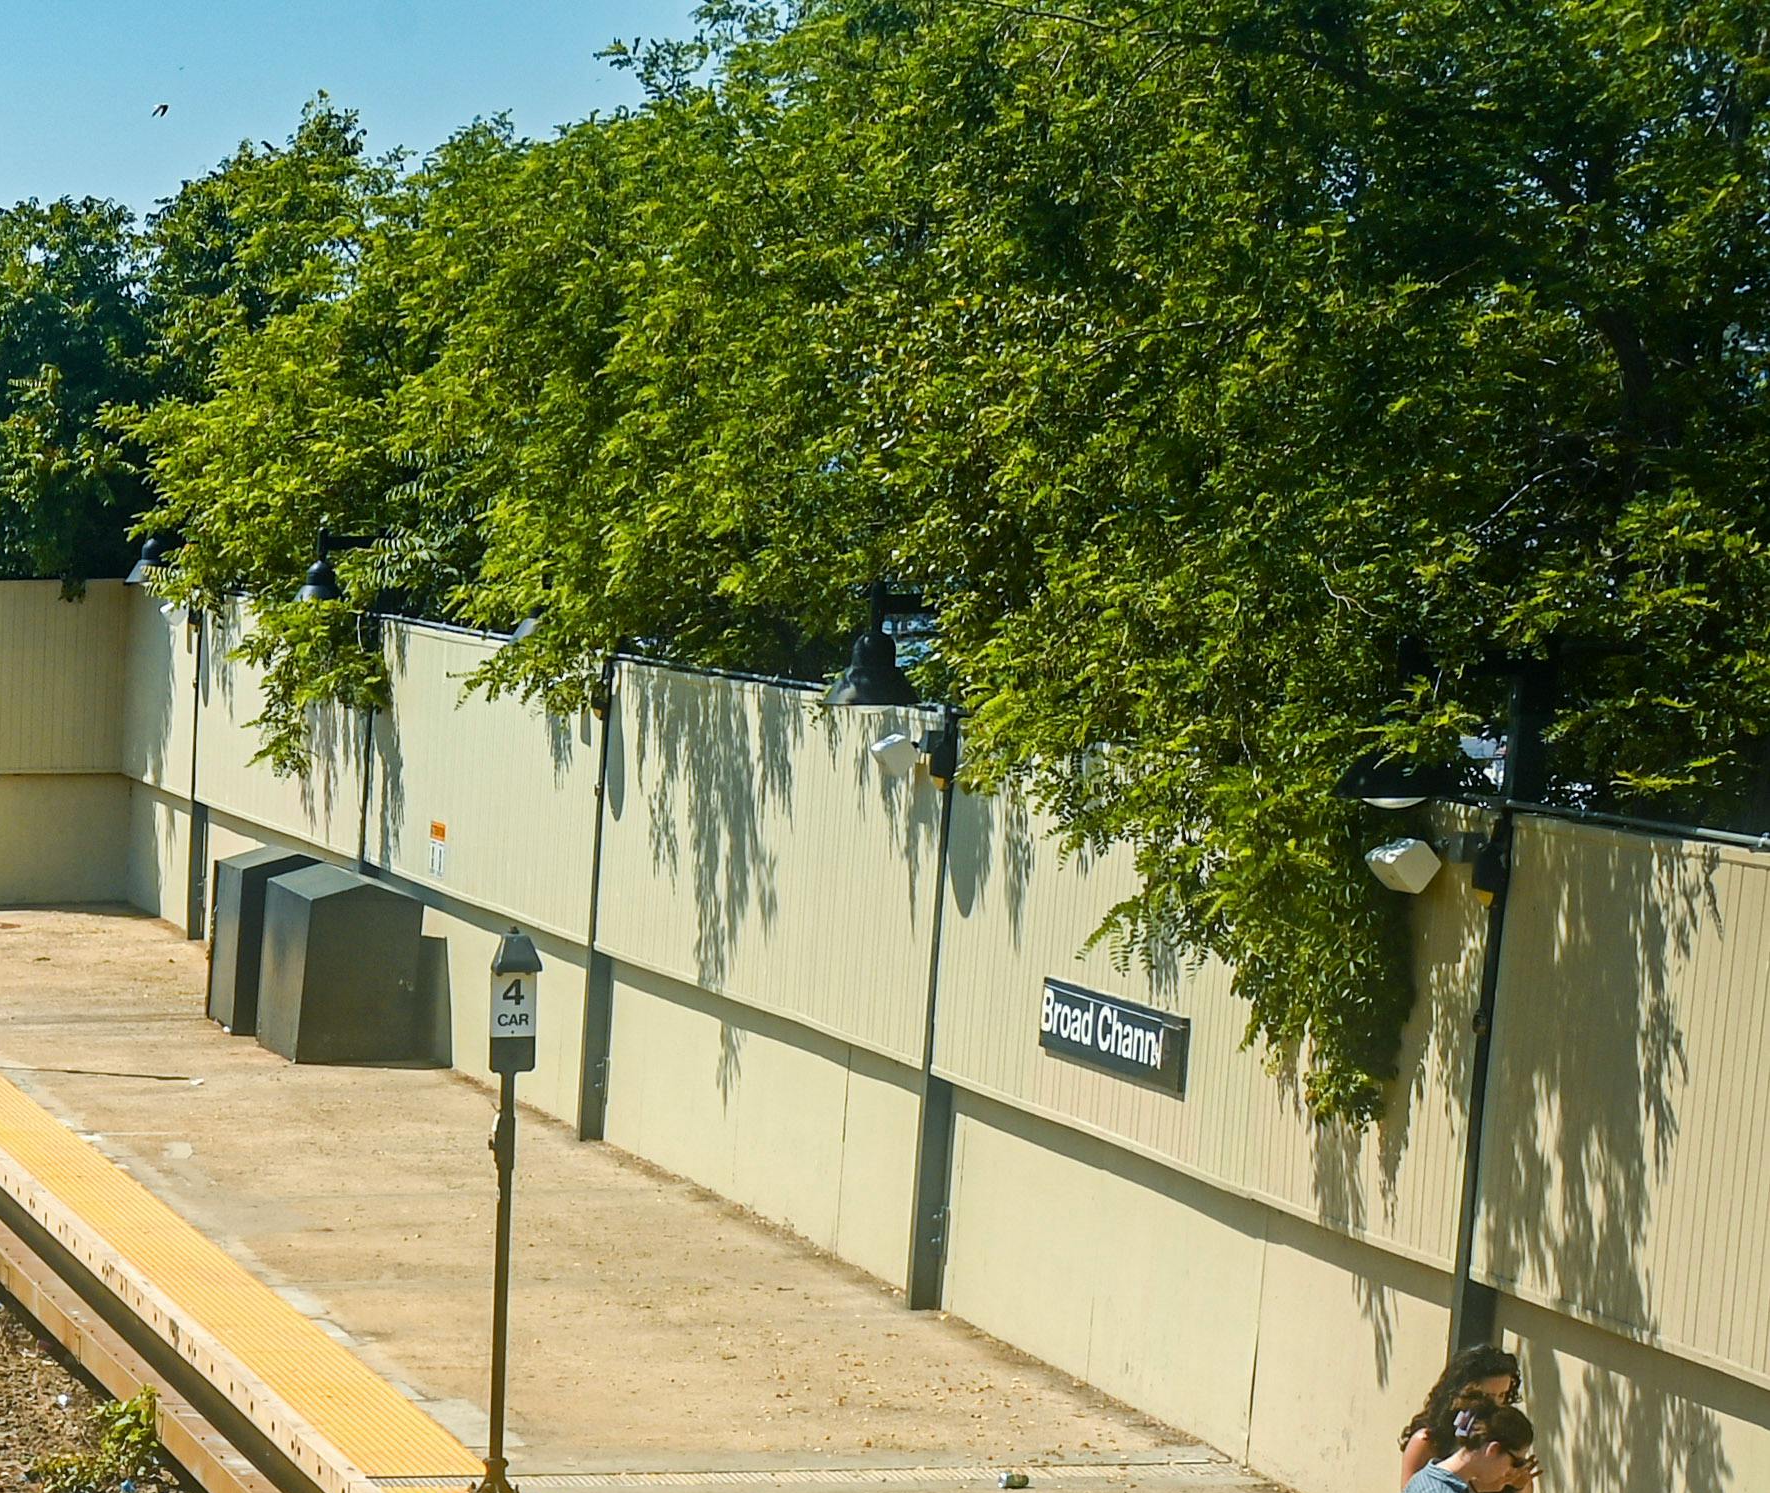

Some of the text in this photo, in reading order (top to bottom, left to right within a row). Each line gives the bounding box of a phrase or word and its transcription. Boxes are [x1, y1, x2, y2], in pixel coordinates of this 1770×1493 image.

[502, 979, 525, 1006] 4
[497, 1013, 529, 1027] CAR
[1041, 987, 1094, 1046] Broad
